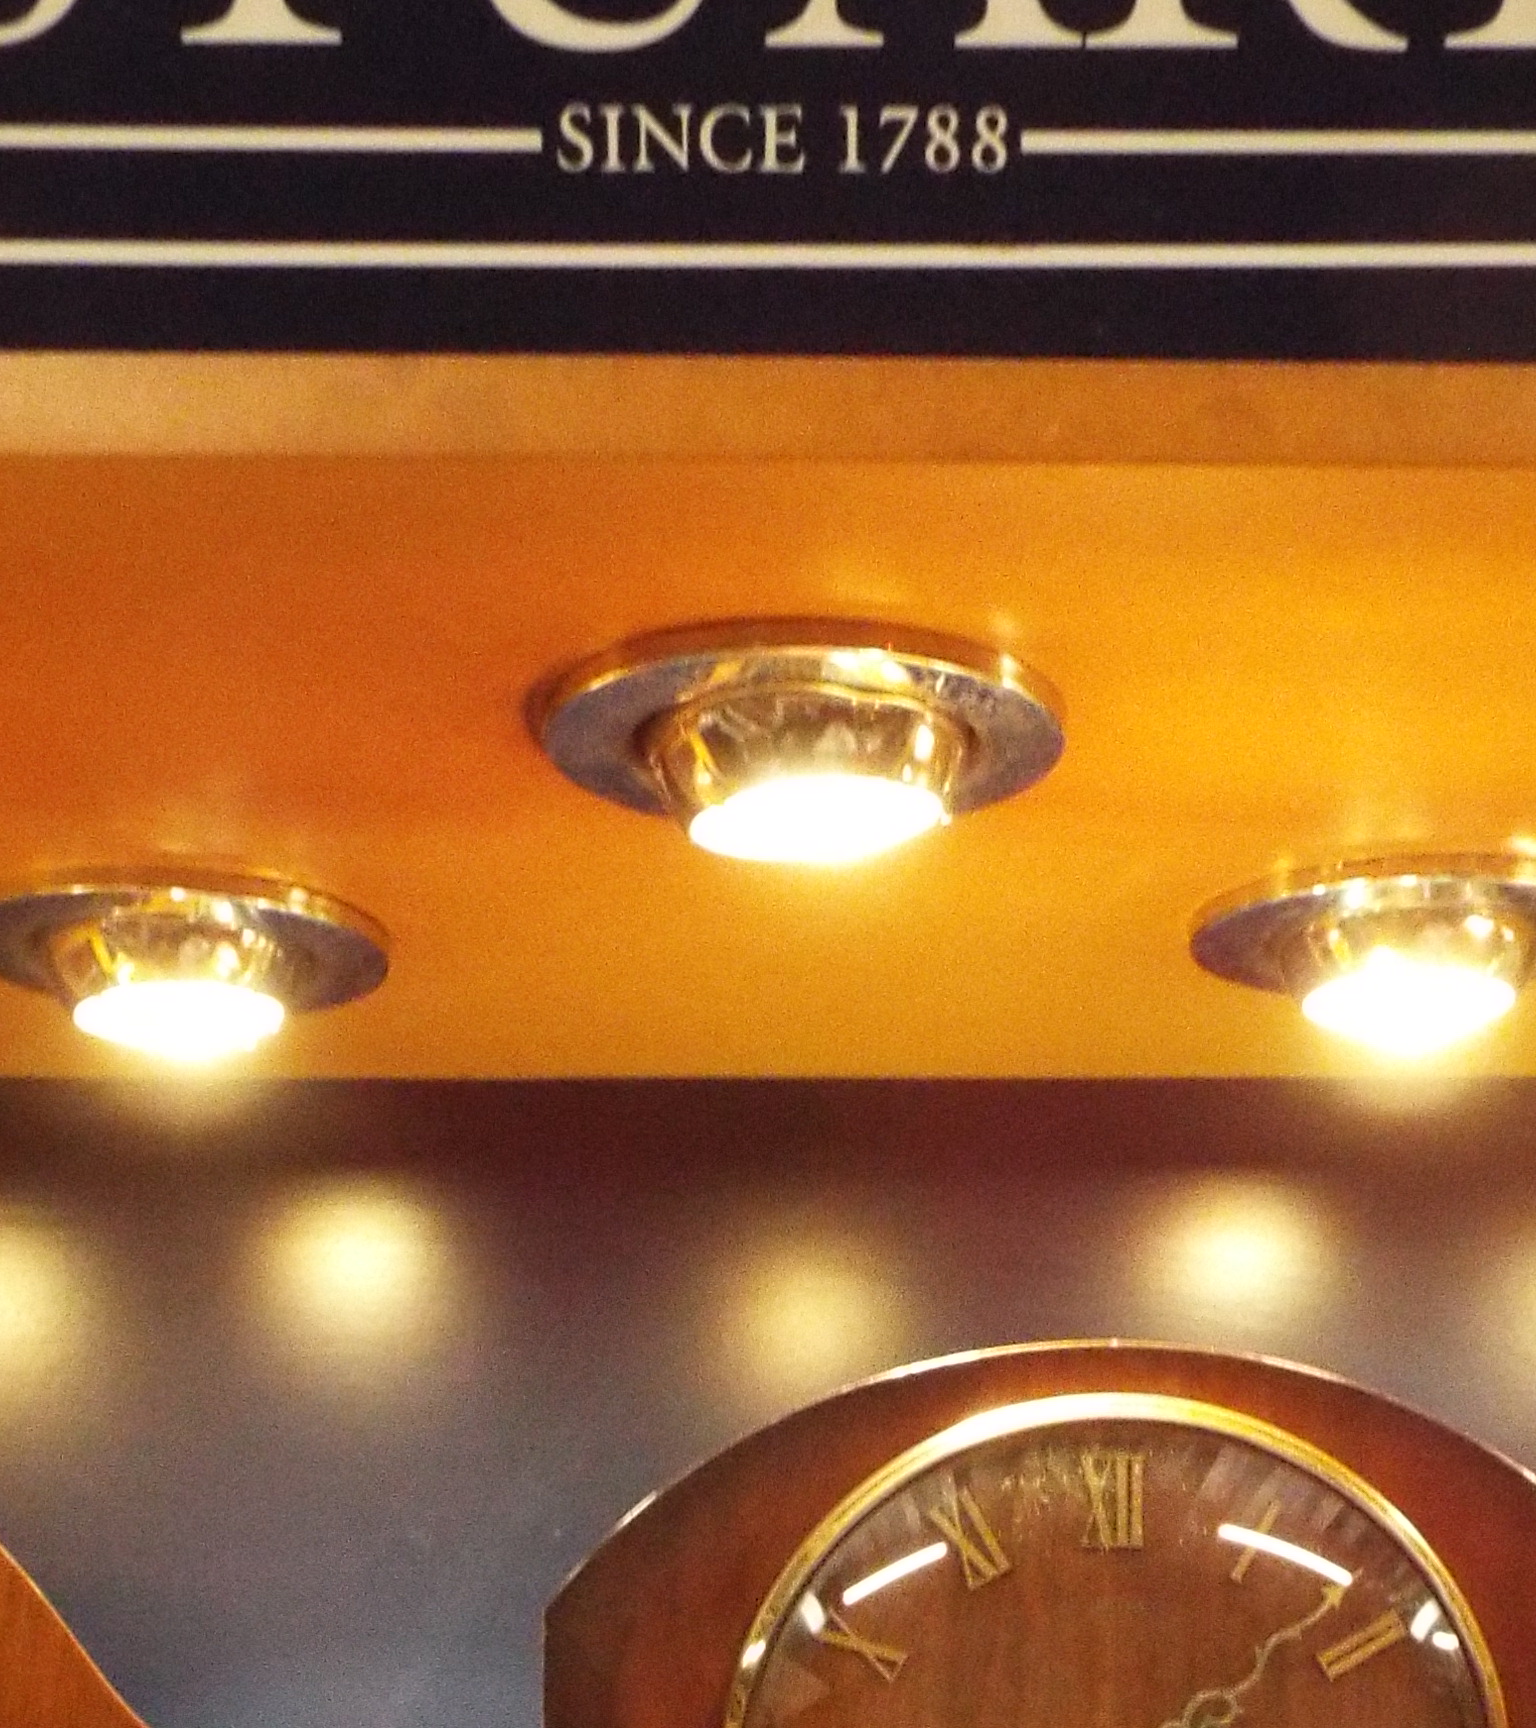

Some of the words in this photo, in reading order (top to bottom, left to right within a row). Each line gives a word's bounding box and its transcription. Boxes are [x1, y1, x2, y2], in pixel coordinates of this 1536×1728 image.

[557, 102, 806, 175] SINCE
[838, 103, 1009, 175] 1788
[927, 1470, 1012, 1590] XI
[1080, 1454, 1145, 1548] XII
[818, 1606, 909, 1684] X
[1316, 1608, 1406, 1682] II
